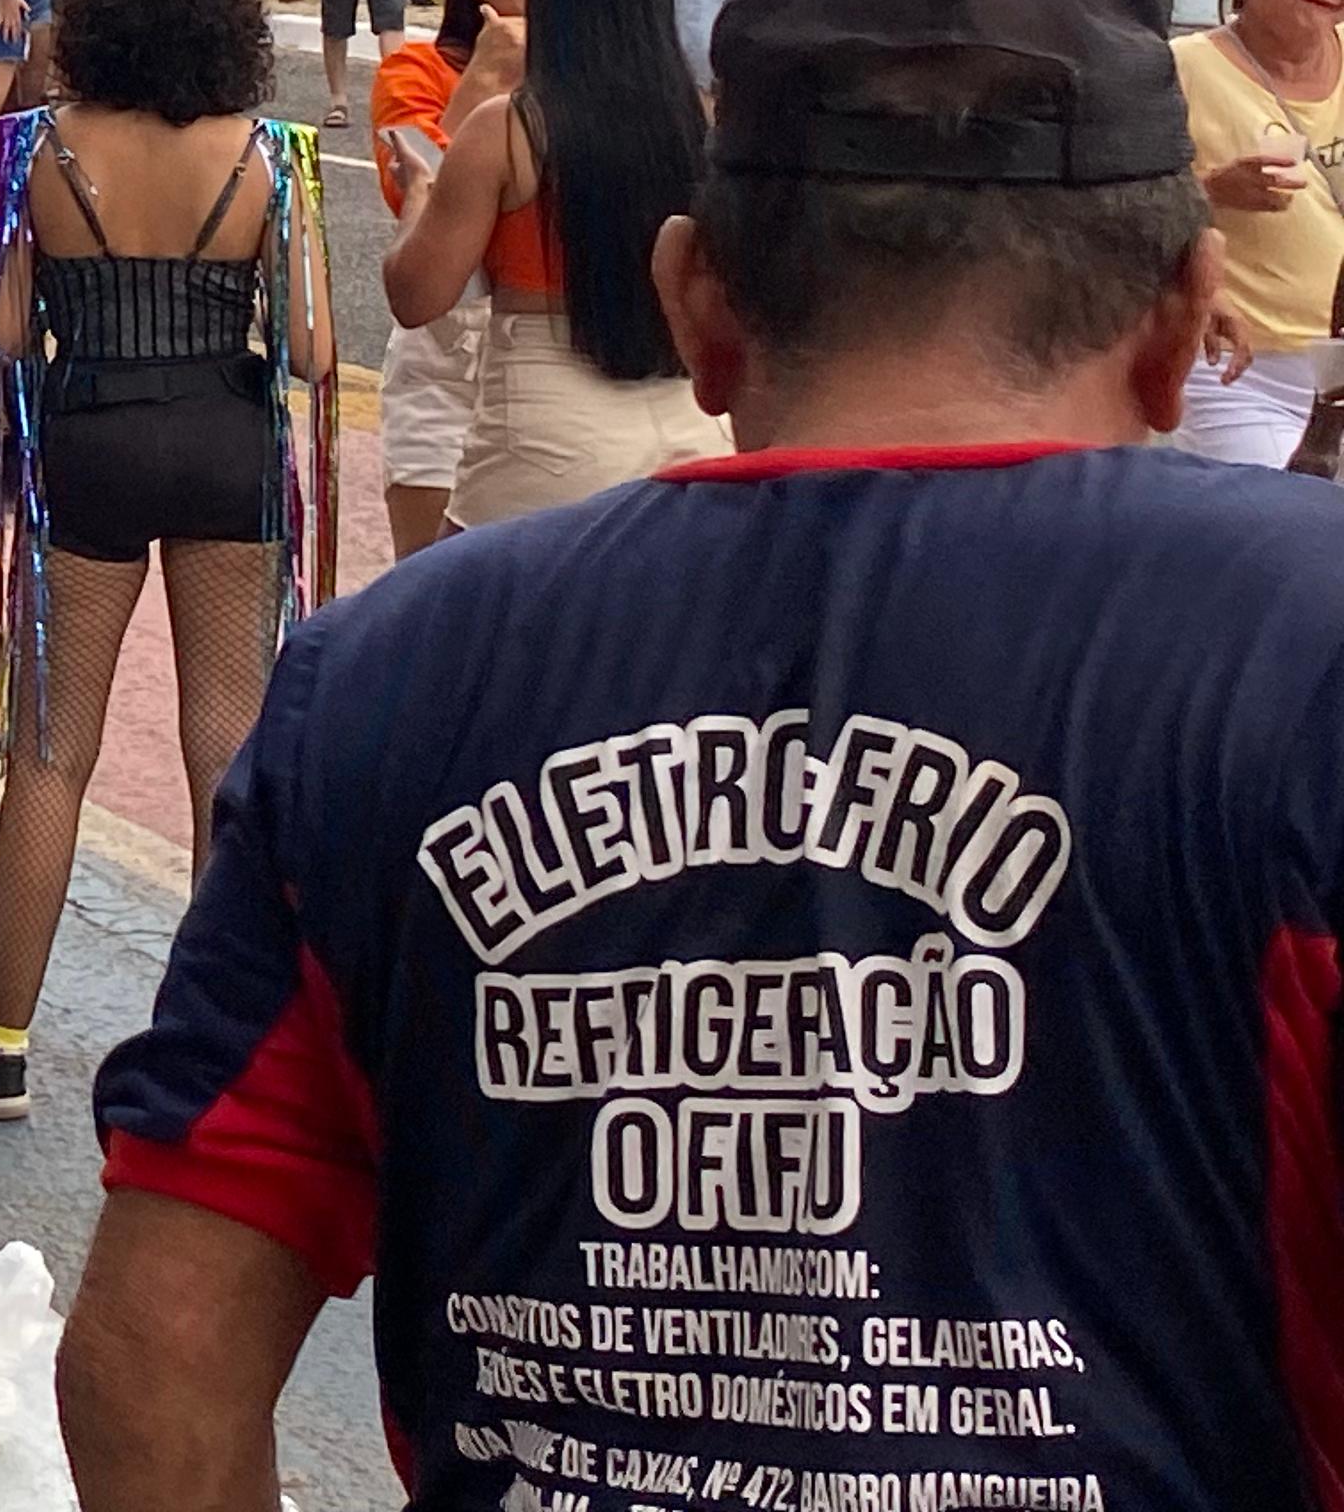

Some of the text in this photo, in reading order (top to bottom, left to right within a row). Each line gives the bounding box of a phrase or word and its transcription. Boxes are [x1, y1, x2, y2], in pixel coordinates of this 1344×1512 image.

[589, 1304, 635, 1354] DE
[862, 1317, 1086, 1374] GELADEIRAS,
[547, 1363, 577, 1405] E
[572, 1366, 704, 1418] ELETRO
[882, 1384, 940, 1435] EM
[949, 1385, 1077, 1438] GERAL.
[800, 1470, 902, 1512] BAIRRO
[909, 1472, 1106, 1512] MANGUEIRA
